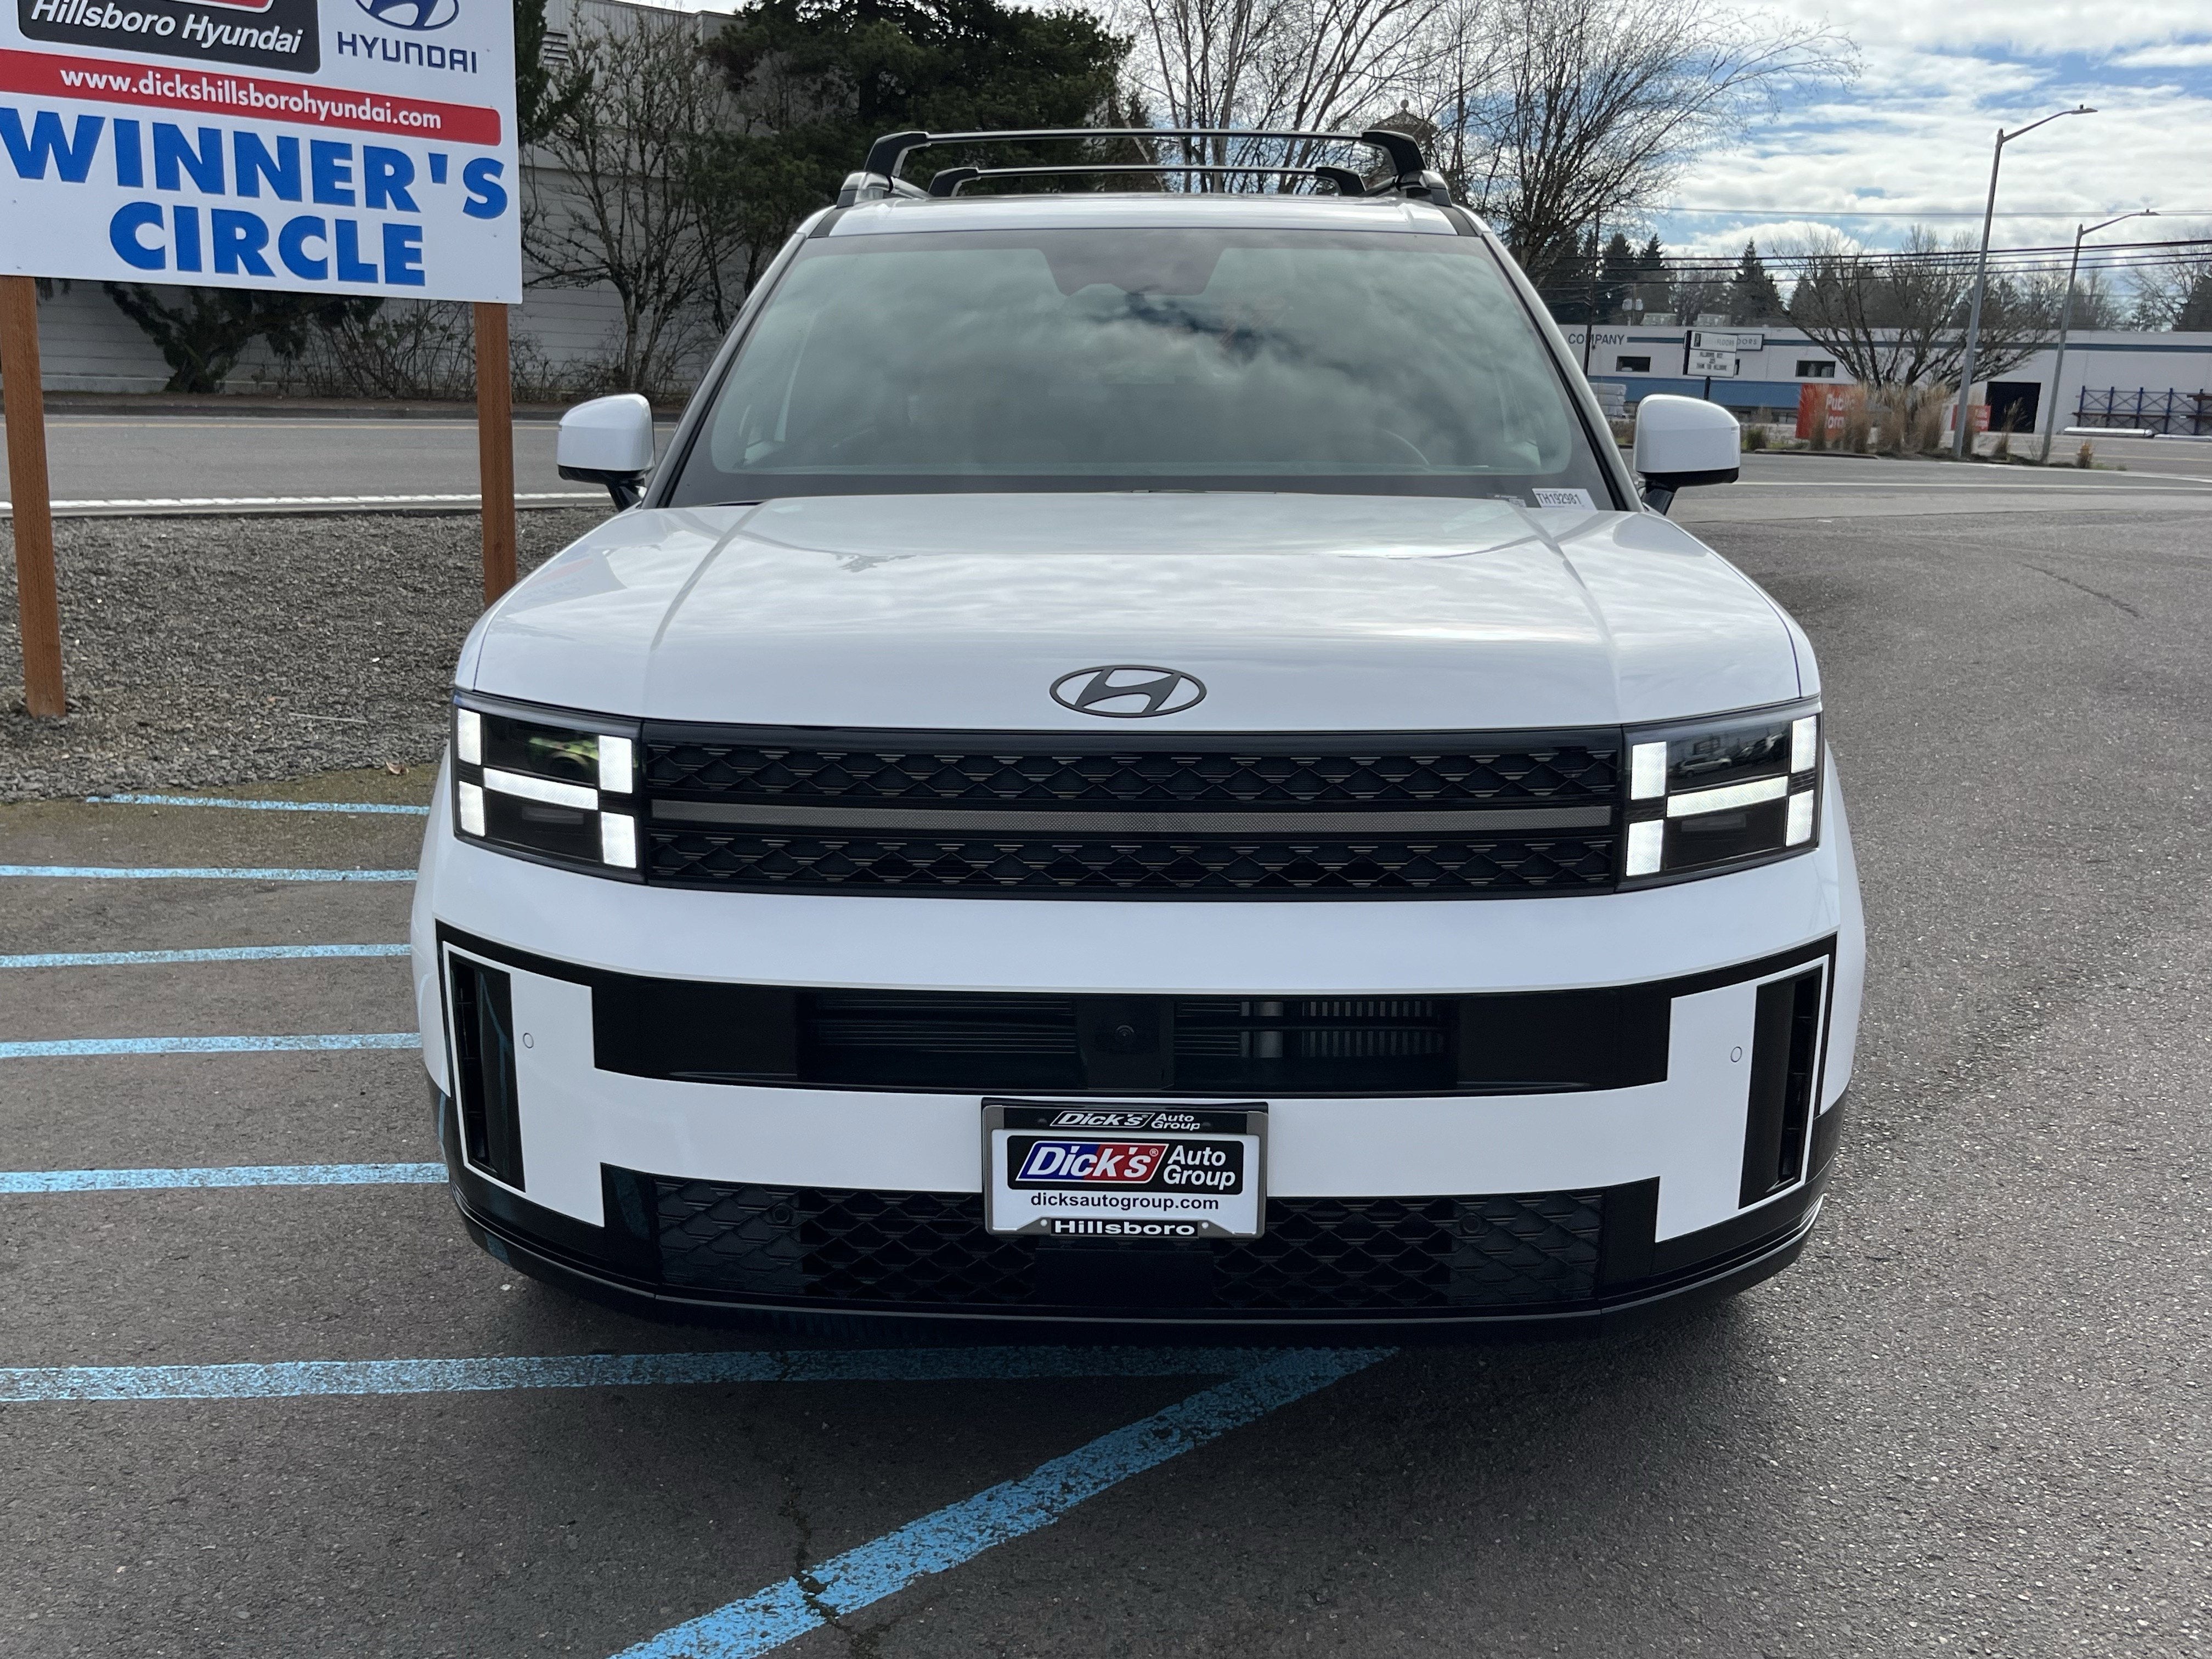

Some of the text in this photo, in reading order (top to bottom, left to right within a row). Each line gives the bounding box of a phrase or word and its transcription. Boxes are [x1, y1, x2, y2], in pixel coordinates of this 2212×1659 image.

[31, 0, 303, 54] Hillsboro Hyundai
[337, 31, 477, 74] HYUNDAI
[60, 67, 441, 130] www.dickshillsborohyundai.com
[0, 107, 508, 219] WINNER'S
[110, 201, 426, 286] CIRCLE
[1151, 1120, 1200, 1131] Group
[1155, 1113, 1195, 1122] Auto
[1027, 1145, 1151, 1178] Dick's
[1167, 1145, 1227, 1167] Auto
[1163, 1164, 1236, 1191] Group
[1030, 1192, 1219, 1211] dicksautogroup.com
[1054, 1220, 1195, 1236] Hillsboro
